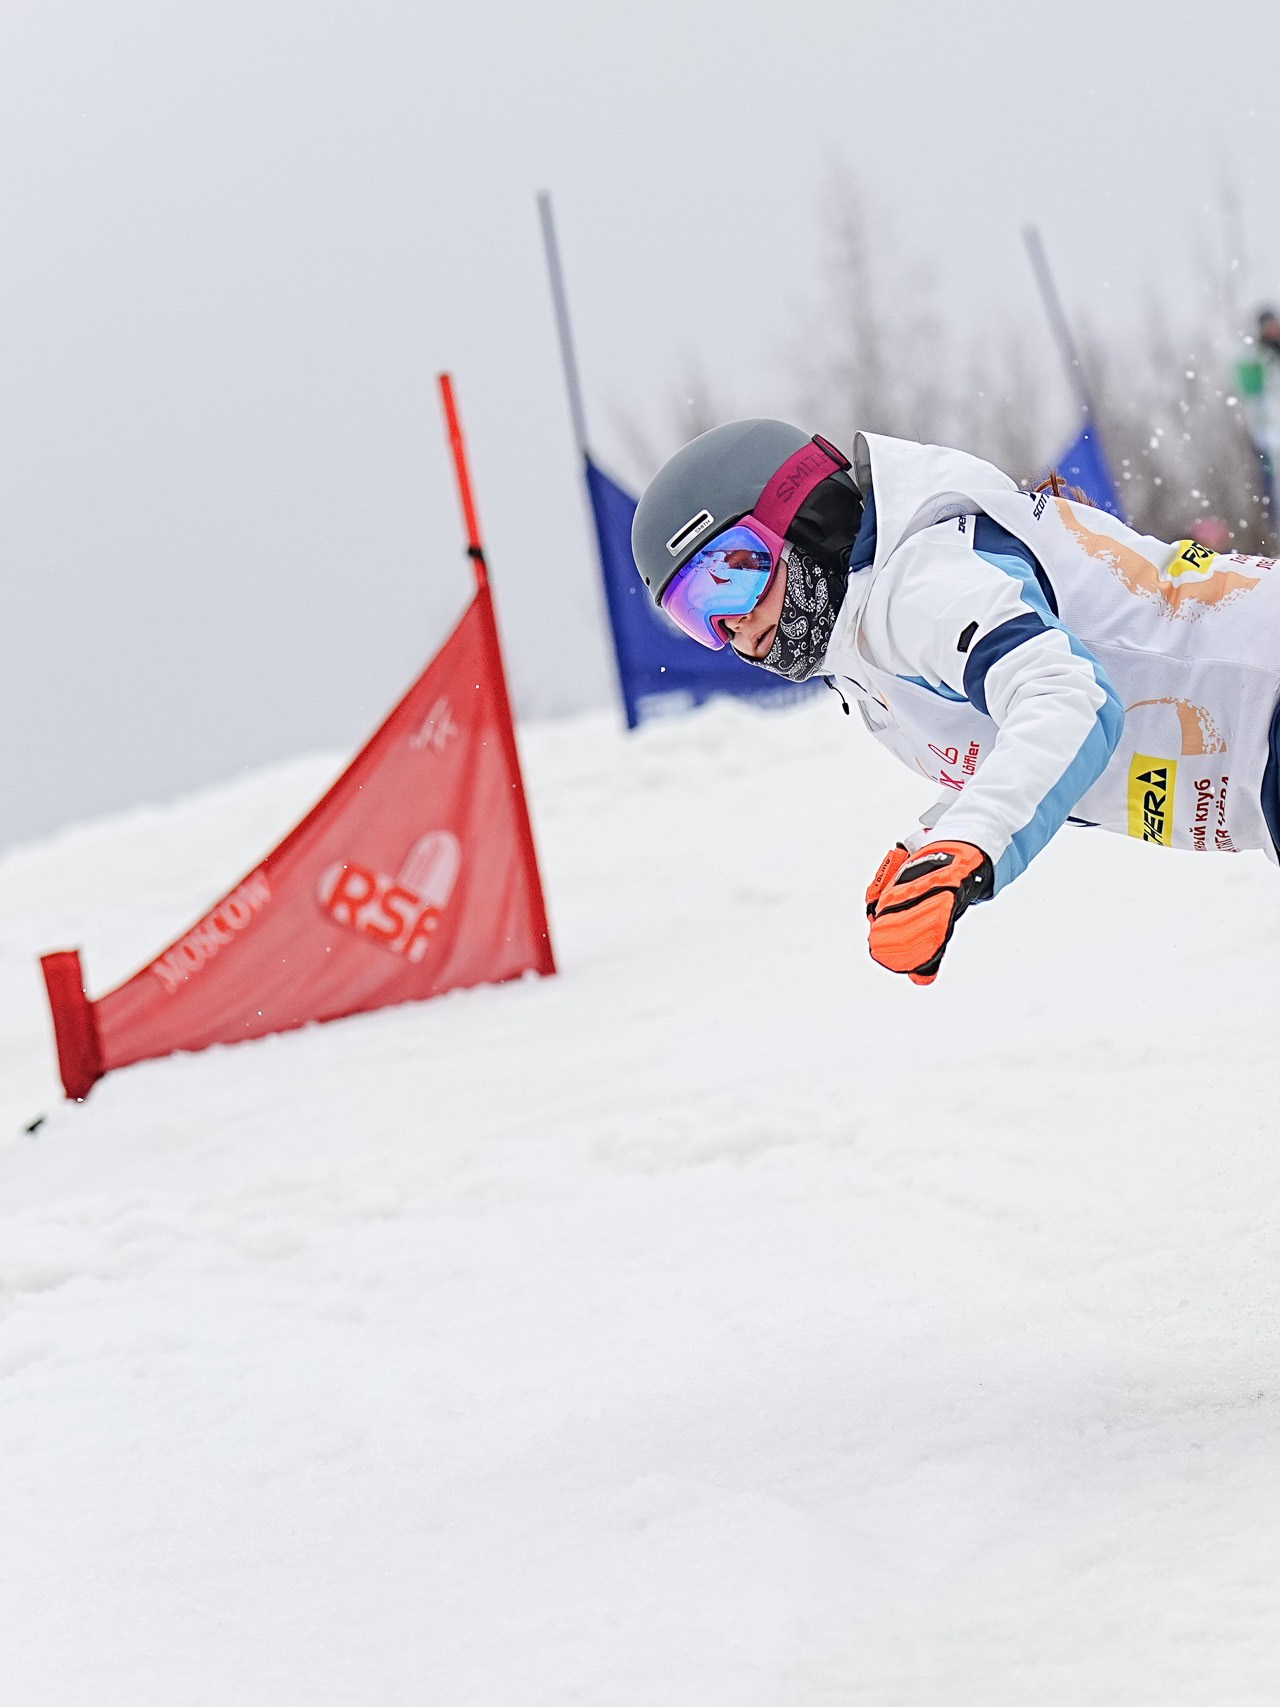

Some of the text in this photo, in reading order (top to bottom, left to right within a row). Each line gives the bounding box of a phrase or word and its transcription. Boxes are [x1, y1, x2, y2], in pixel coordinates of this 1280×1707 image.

[961, 740, 980, 776] Löffler
[1143, 789, 1167, 847] HER
[1194, 778, 1215, 822] клуб
[152, 869, 273, 992] MOSCOW
